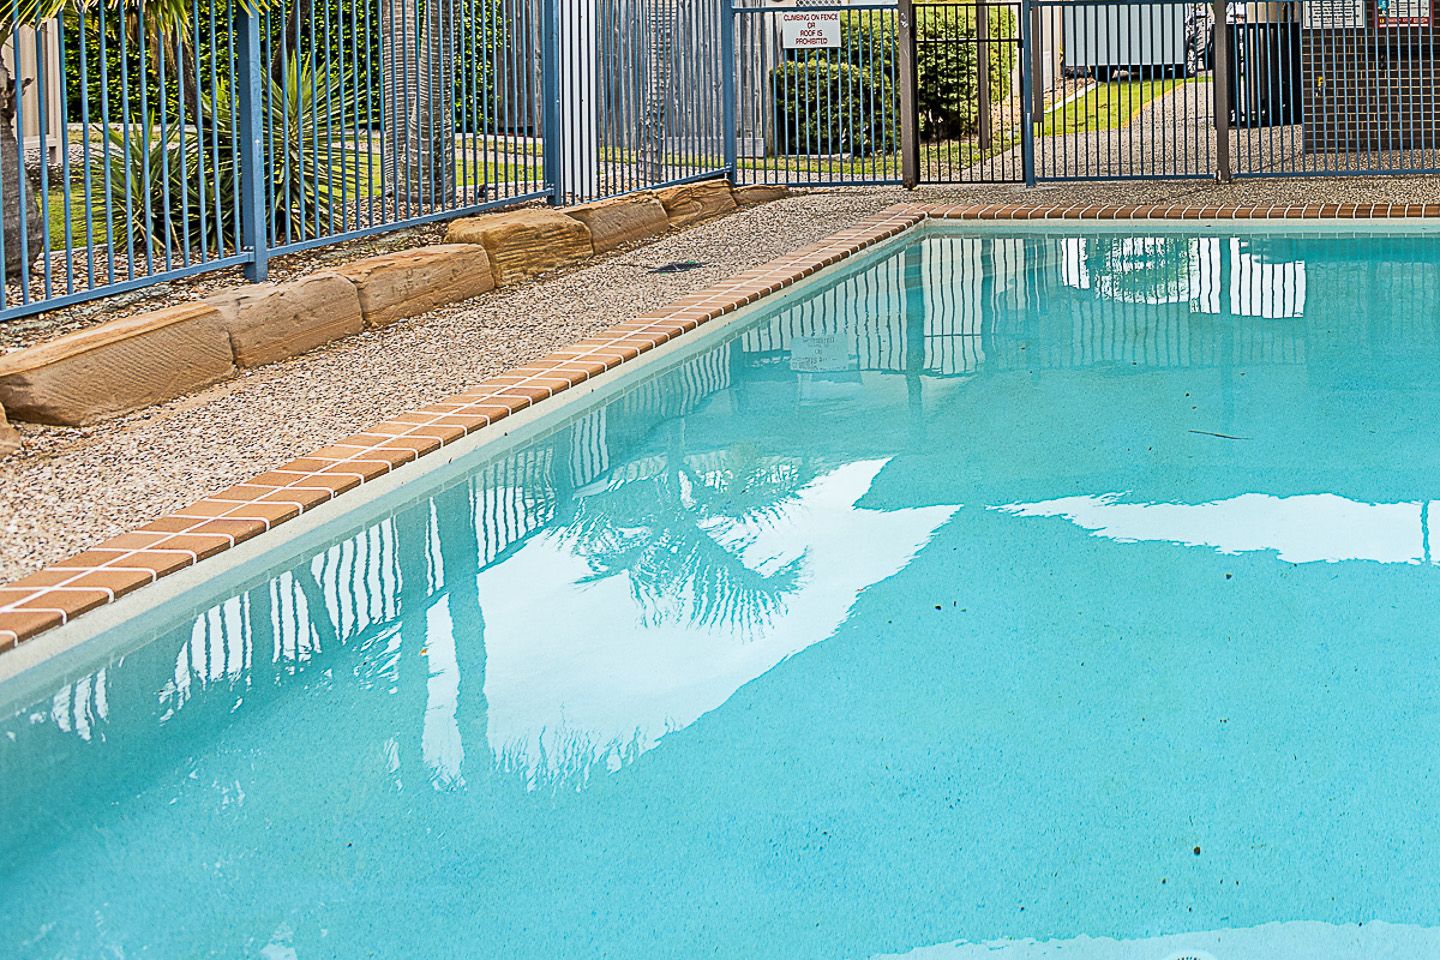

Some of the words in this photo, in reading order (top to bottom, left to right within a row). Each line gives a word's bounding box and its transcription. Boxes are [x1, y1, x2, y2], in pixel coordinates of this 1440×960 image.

[810, 13, 820, 21] ON
[820, 13, 839, 21] FENCE
[800, 29, 815, 37] ROOF
[816, 29, 823, 37] IS
[795, 37, 828, 45] PROHIBITED
